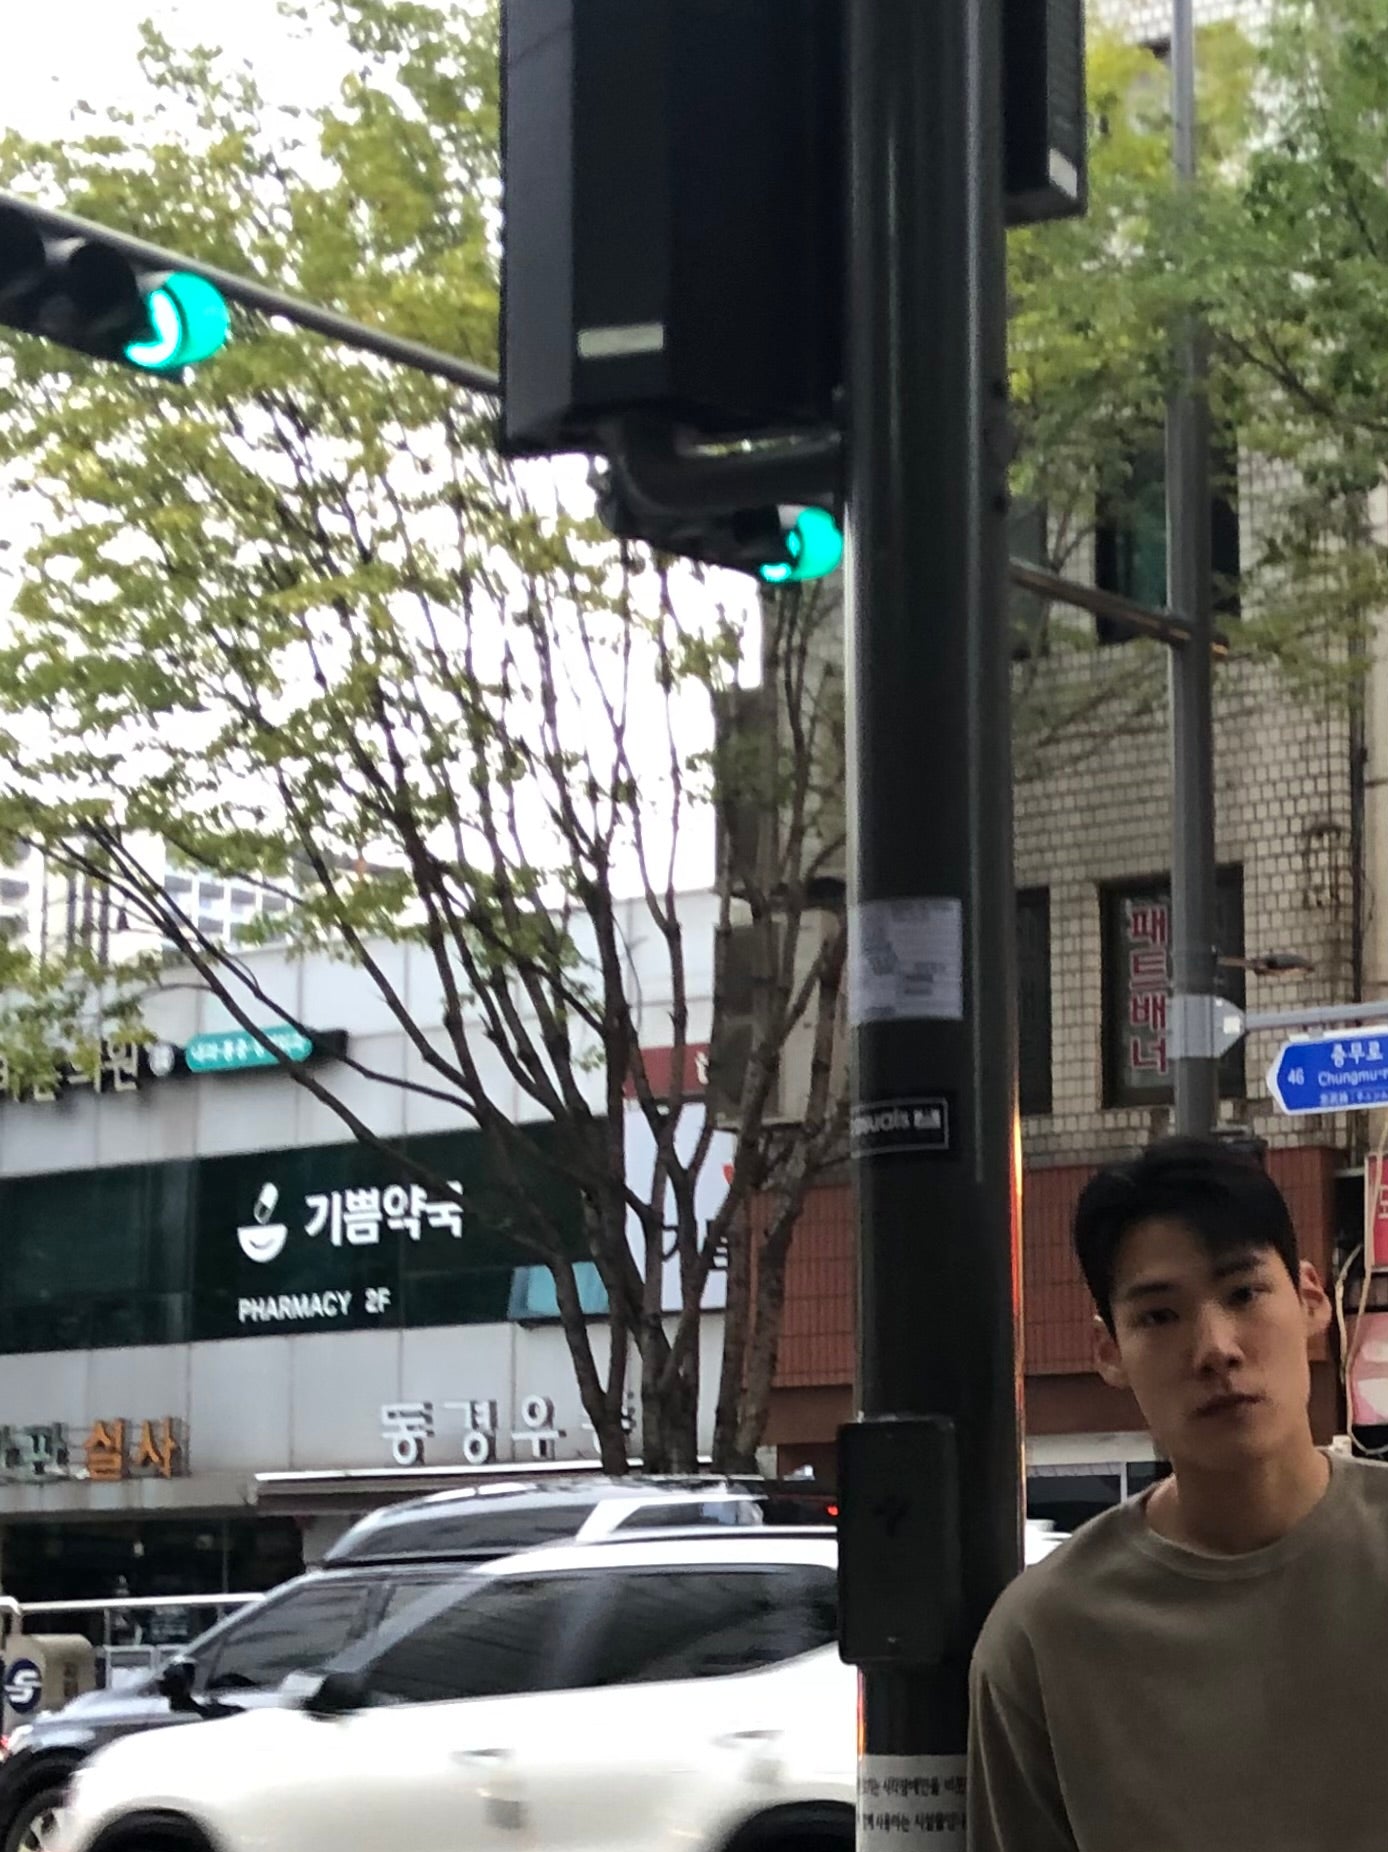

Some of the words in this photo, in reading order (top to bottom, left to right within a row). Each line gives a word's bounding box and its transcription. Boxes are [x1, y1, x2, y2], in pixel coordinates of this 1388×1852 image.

[1130, 905, 1167, 1075] 패트배너
[303, 1180, 464, 1247] 기쁨약국
[238, 1290, 352, 1324] PHARMACY
[364, 1287, 392, 1315] 2F
[85, 1417, 177, 1481] 실사
[381, 1395, 634, 1466] 동경우
